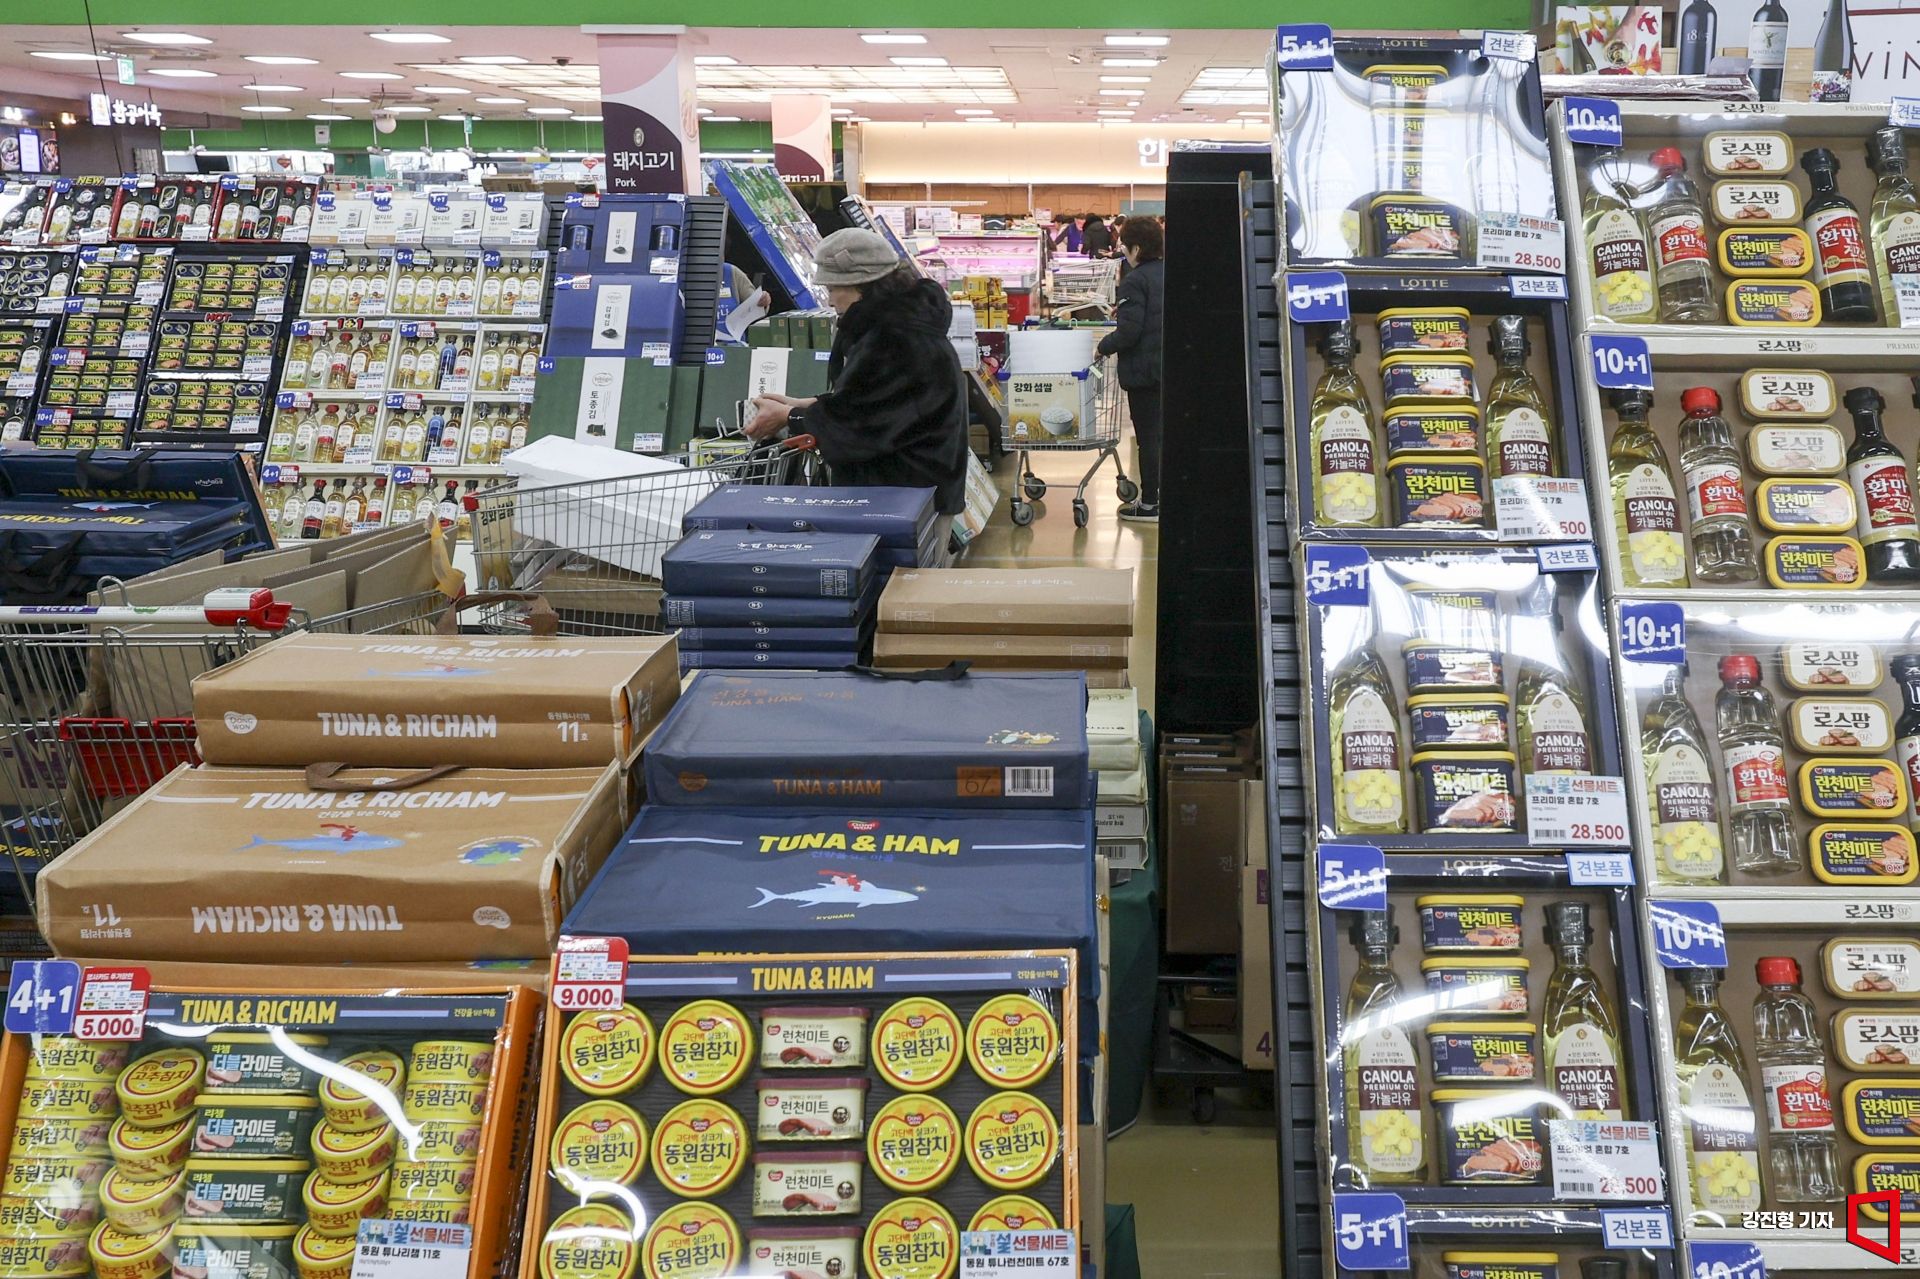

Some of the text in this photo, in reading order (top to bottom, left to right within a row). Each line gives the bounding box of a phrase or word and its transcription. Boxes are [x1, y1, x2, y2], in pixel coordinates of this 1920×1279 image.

[1382, 38, 1428, 48] LOTTE
[1723, 103, 1764, 113] 로스팜
[1568, 107, 1621, 133] 10+1
[1721, 142, 1772, 156] 로스팜
[612, 151, 675, 171] 돼지고기
[77, 176, 102, 185] NEW
[615, 177, 636, 188] Pork
[1386, 213, 1454, 230] 런천미트
[1519, 217, 1560, 233] 선물세트
[1482, 228, 1542, 240] 프리미엄 혼합 7호
[1596, 243, 1642, 256] CANOLA
[1730, 240, 1783, 255] 런천미트
[1515, 252, 1561, 269] 28,500
[1597, 251, 1644, 263] PREMIUM OIL
[1603, 257, 1641, 271] 카놀라유
[1400, 278, 1449, 288] LOTTE
[1517, 279, 1559, 294] 견본품
[1292, 284, 1345, 309] 5+1
[206, 312, 231, 323] HOT
[337, 317, 364, 330] 1+1
[293, 323, 307, 331] 1+1
[401, 325, 417, 333] 5+1
[707, 352, 723, 361] 10+1
[1594, 348, 1649, 374] 10+1
[539, 361, 553, 369] 1+1
[1013, 382, 1033, 394] 강화
[1762, 381, 1815, 396] 로스팜
[37, 413, 53, 421] 10+1
[1323, 442, 1370, 454] CANOLA
[1329, 458, 1367, 471] 카놀라유
[263, 469, 278, 478] 4+1
[394, 470, 411, 478] 4+1
[1405, 475, 1478, 495] 런천미트
[1545, 548, 1590, 565] 견본품
[1309, 560, 1366, 591] 5+1
[1622, 616, 1684, 646] 10+1
[359, 643, 441, 656] TUNA
[465, 647, 585, 658] RICHAM
[317, 711, 497, 738] TUNA & RICHAM
[1814, 712, 1871, 728] 로스팜
[772, 779, 883, 796] TUNA & HAM
[1557, 777, 1619, 794] 설 선물세트
[1814, 775, 1875, 793] 런천미트
[243, 791, 506, 810] TUNA & RICHAM
[1532, 795, 1600, 805] 프리미엄 혼합 7호
[1660, 787, 1711, 800] CANOLA
[1667, 805, 1709, 818] 카놀라유
[1571, 823, 1624, 841] 28,500
[759, 832, 847, 853] TUNA
[851, 834, 877, 852] &
[882, 834, 960, 856] HAM
[1323, 860, 1386, 890] 5+1
[1577, 861, 1624, 878] 견본품
[191, 903, 403, 933] TUNA & RICHAM
[1845, 903, 1894, 918] 로스팜
[1458, 911, 1517, 930] 런천미트
[751, 966, 874, 991] TUNA & HAM
[9, 979, 72, 1014] 4+1
[181, 999, 337, 1024] TUNA & RICHAM
[782, 1029, 831, 1044] 런천미트
[1256, 1031, 1272, 1058] 4
[574, 1037, 641, 1067] 동원참치
[671, 1040, 738, 1063] 동원참치
[885, 1036, 951, 1062] 동원참치
[980, 1035, 1046, 1059] 동원참치
[212, 1053, 285, 1072] 더블라이트
[416, 1053, 469, 1072] 동원참치
[130, 1068, 191, 1082] 고추참치
[1362, 1069, 1416, 1084] CANOLA
[1364, 1083, 1416, 1091] PREMIUM OIL
[30, 1088, 91, 1108] 동원참치
[1369, 1092, 1412, 1106] 카놀라유
[780, 1100, 829, 1116] 런천미트
[206, 1118, 277, 1137] 더블라이트
[565, 1142, 634, 1166] 동원참치
[881, 1137, 948, 1161] 동원참치
[393, 1222, 465, 1245] 설 선물세트
[1340, 1214, 1403, 1251] 5+1
[1612, 1218, 1663, 1240] 견본품
[996, 1232, 1069, 1254] 설 선물세트
[361, 1245, 380, 1256] 동원
[422, 1249, 441, 1259] 11호
[966, 1257, 985, 1268] 동원
[1047, 1256, 1070, 1267] 67호
